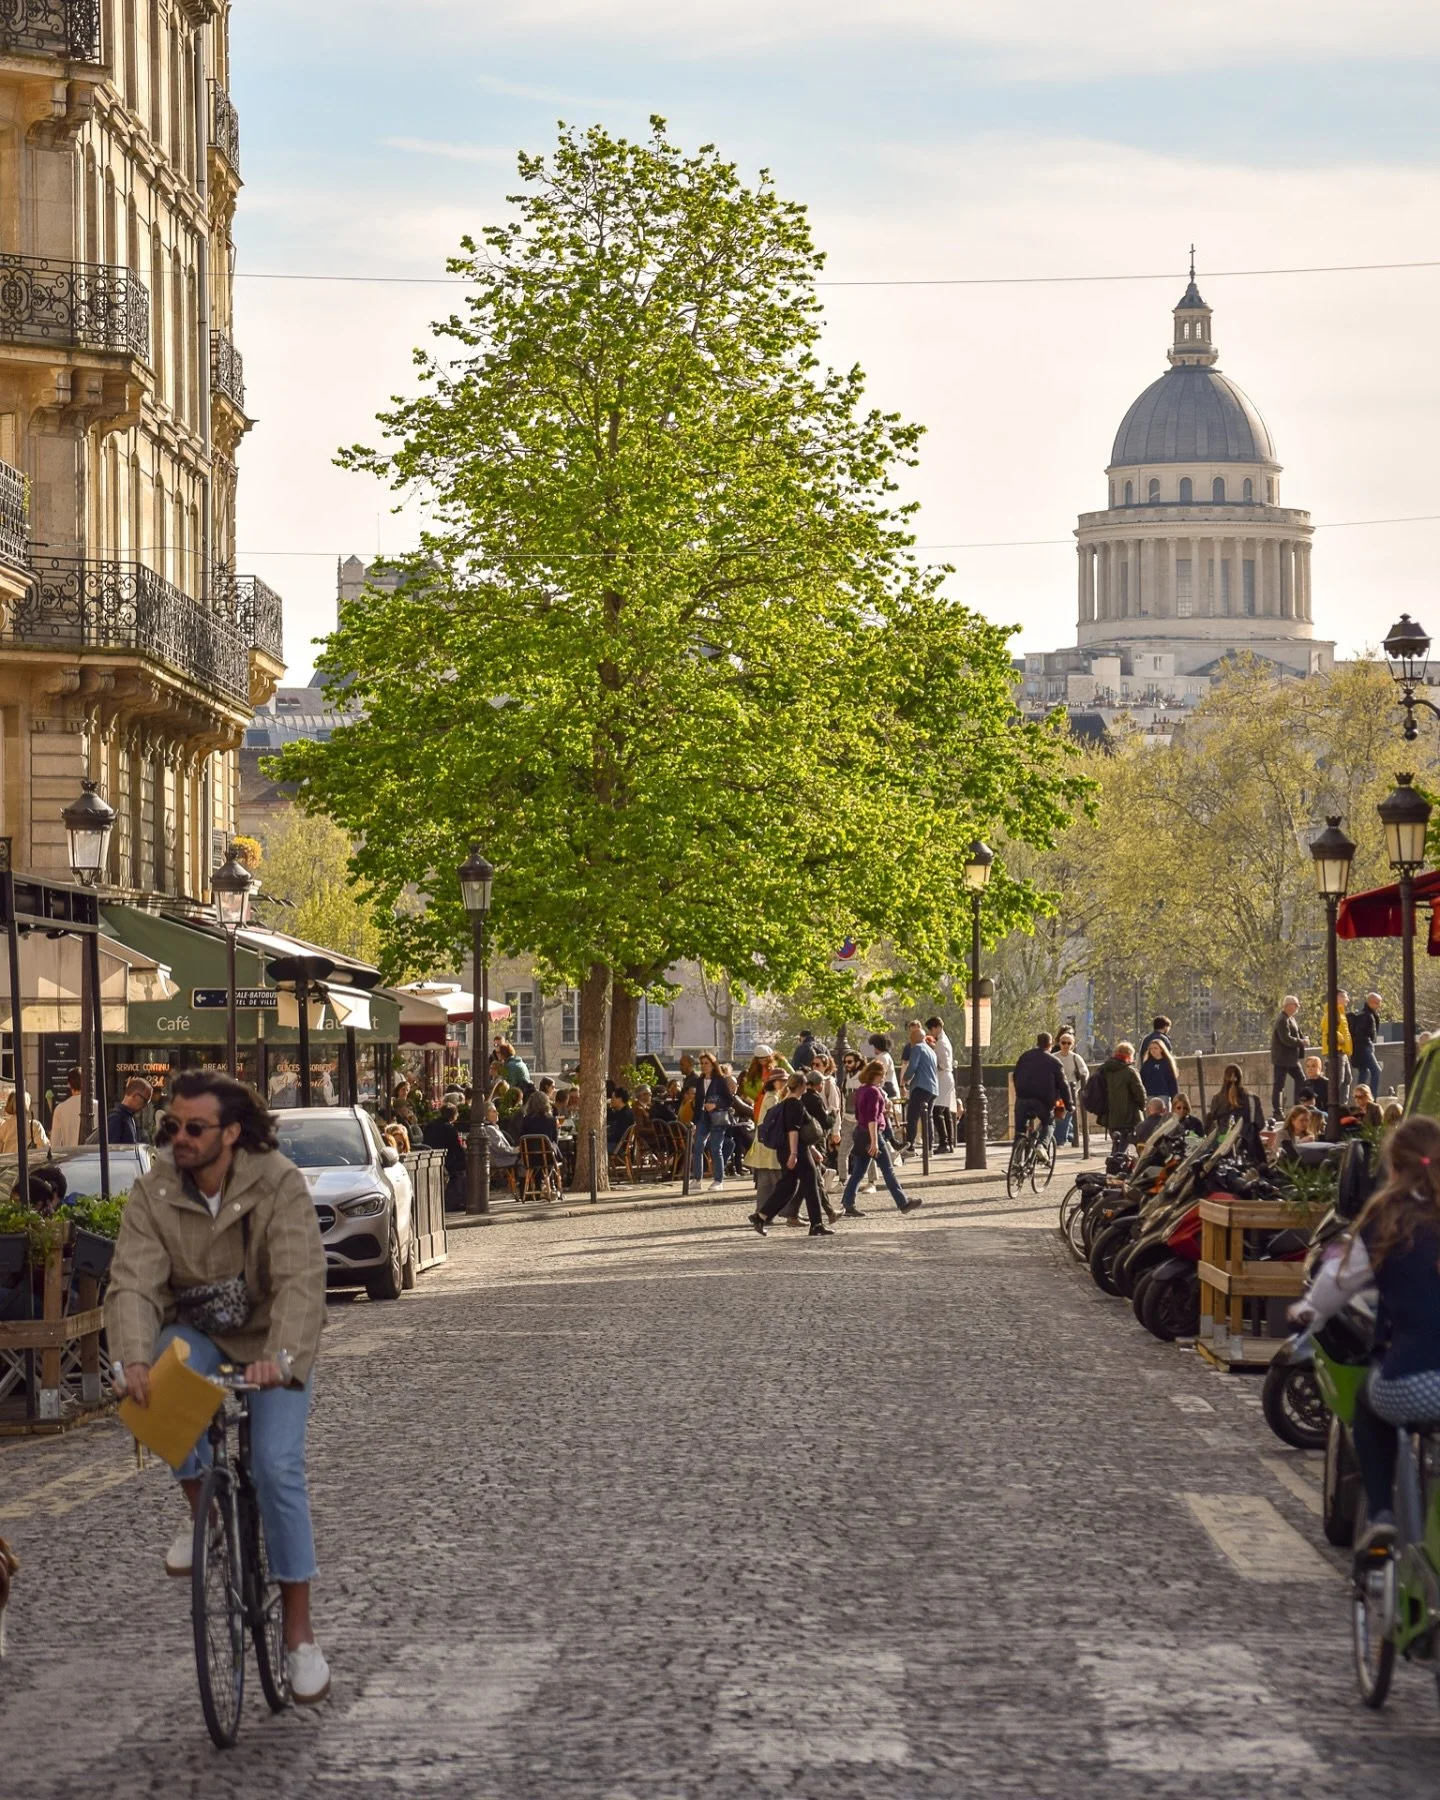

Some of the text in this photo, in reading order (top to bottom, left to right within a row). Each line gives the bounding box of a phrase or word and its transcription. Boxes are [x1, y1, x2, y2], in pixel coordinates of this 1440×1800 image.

[157, 1015, 190, 1031] Café
[116, 1063, 170, 1071] SERVICE CONTINU
[202, 1063, 244, 1071] BREAKST
